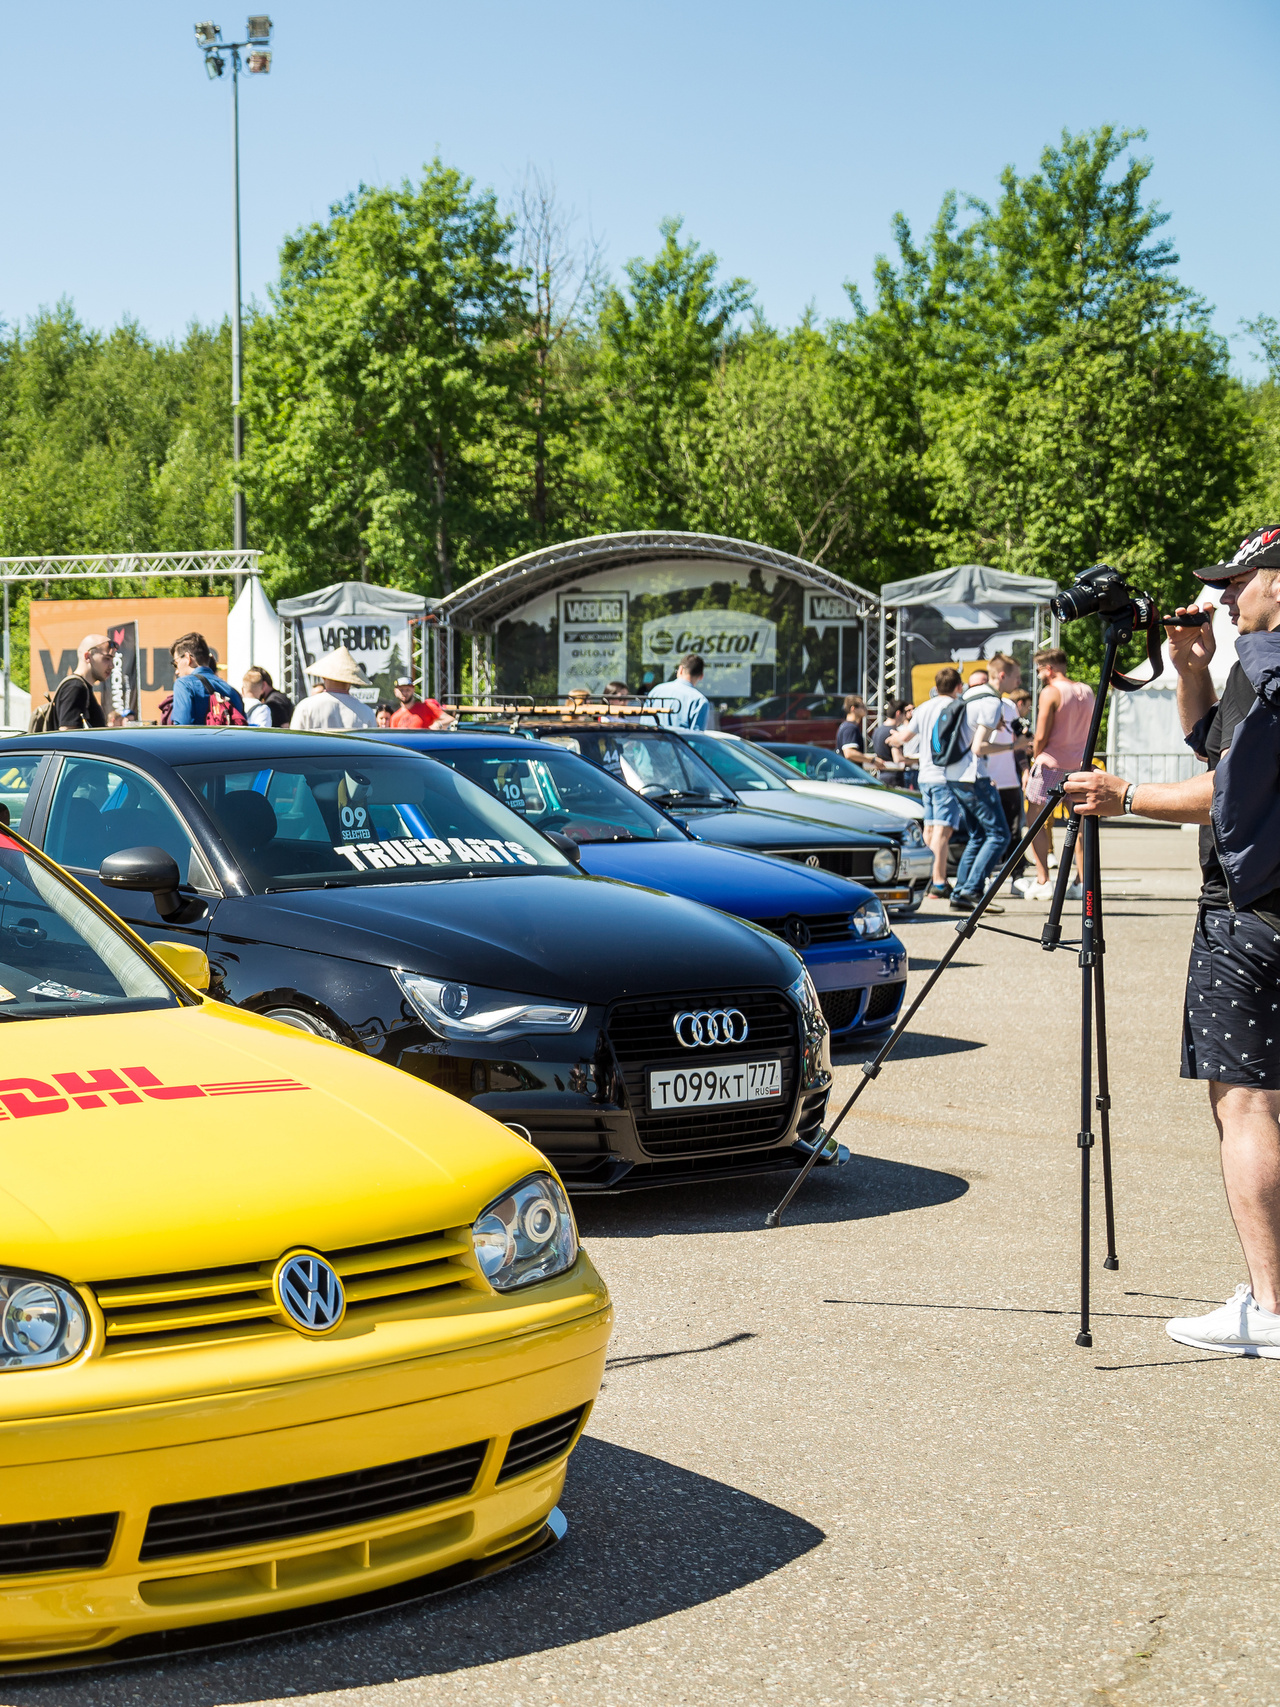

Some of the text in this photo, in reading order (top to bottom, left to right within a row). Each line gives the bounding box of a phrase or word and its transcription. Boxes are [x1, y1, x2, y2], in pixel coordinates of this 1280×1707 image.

[566, 602, 621, 622] VAGBURG
[318, 625, 391, 652] VAGBURG
[675, 630, 760, 654] Castrol
[603, 749, 620, 764] 44
[502, 784, 521, 799] 10
[340, 806, 368, 828] 09
[1086, 890, 1094, 917] BOSCH
[748, 1062, 777, 1088] 777
[755, 1087, 770, 1096] RUS
